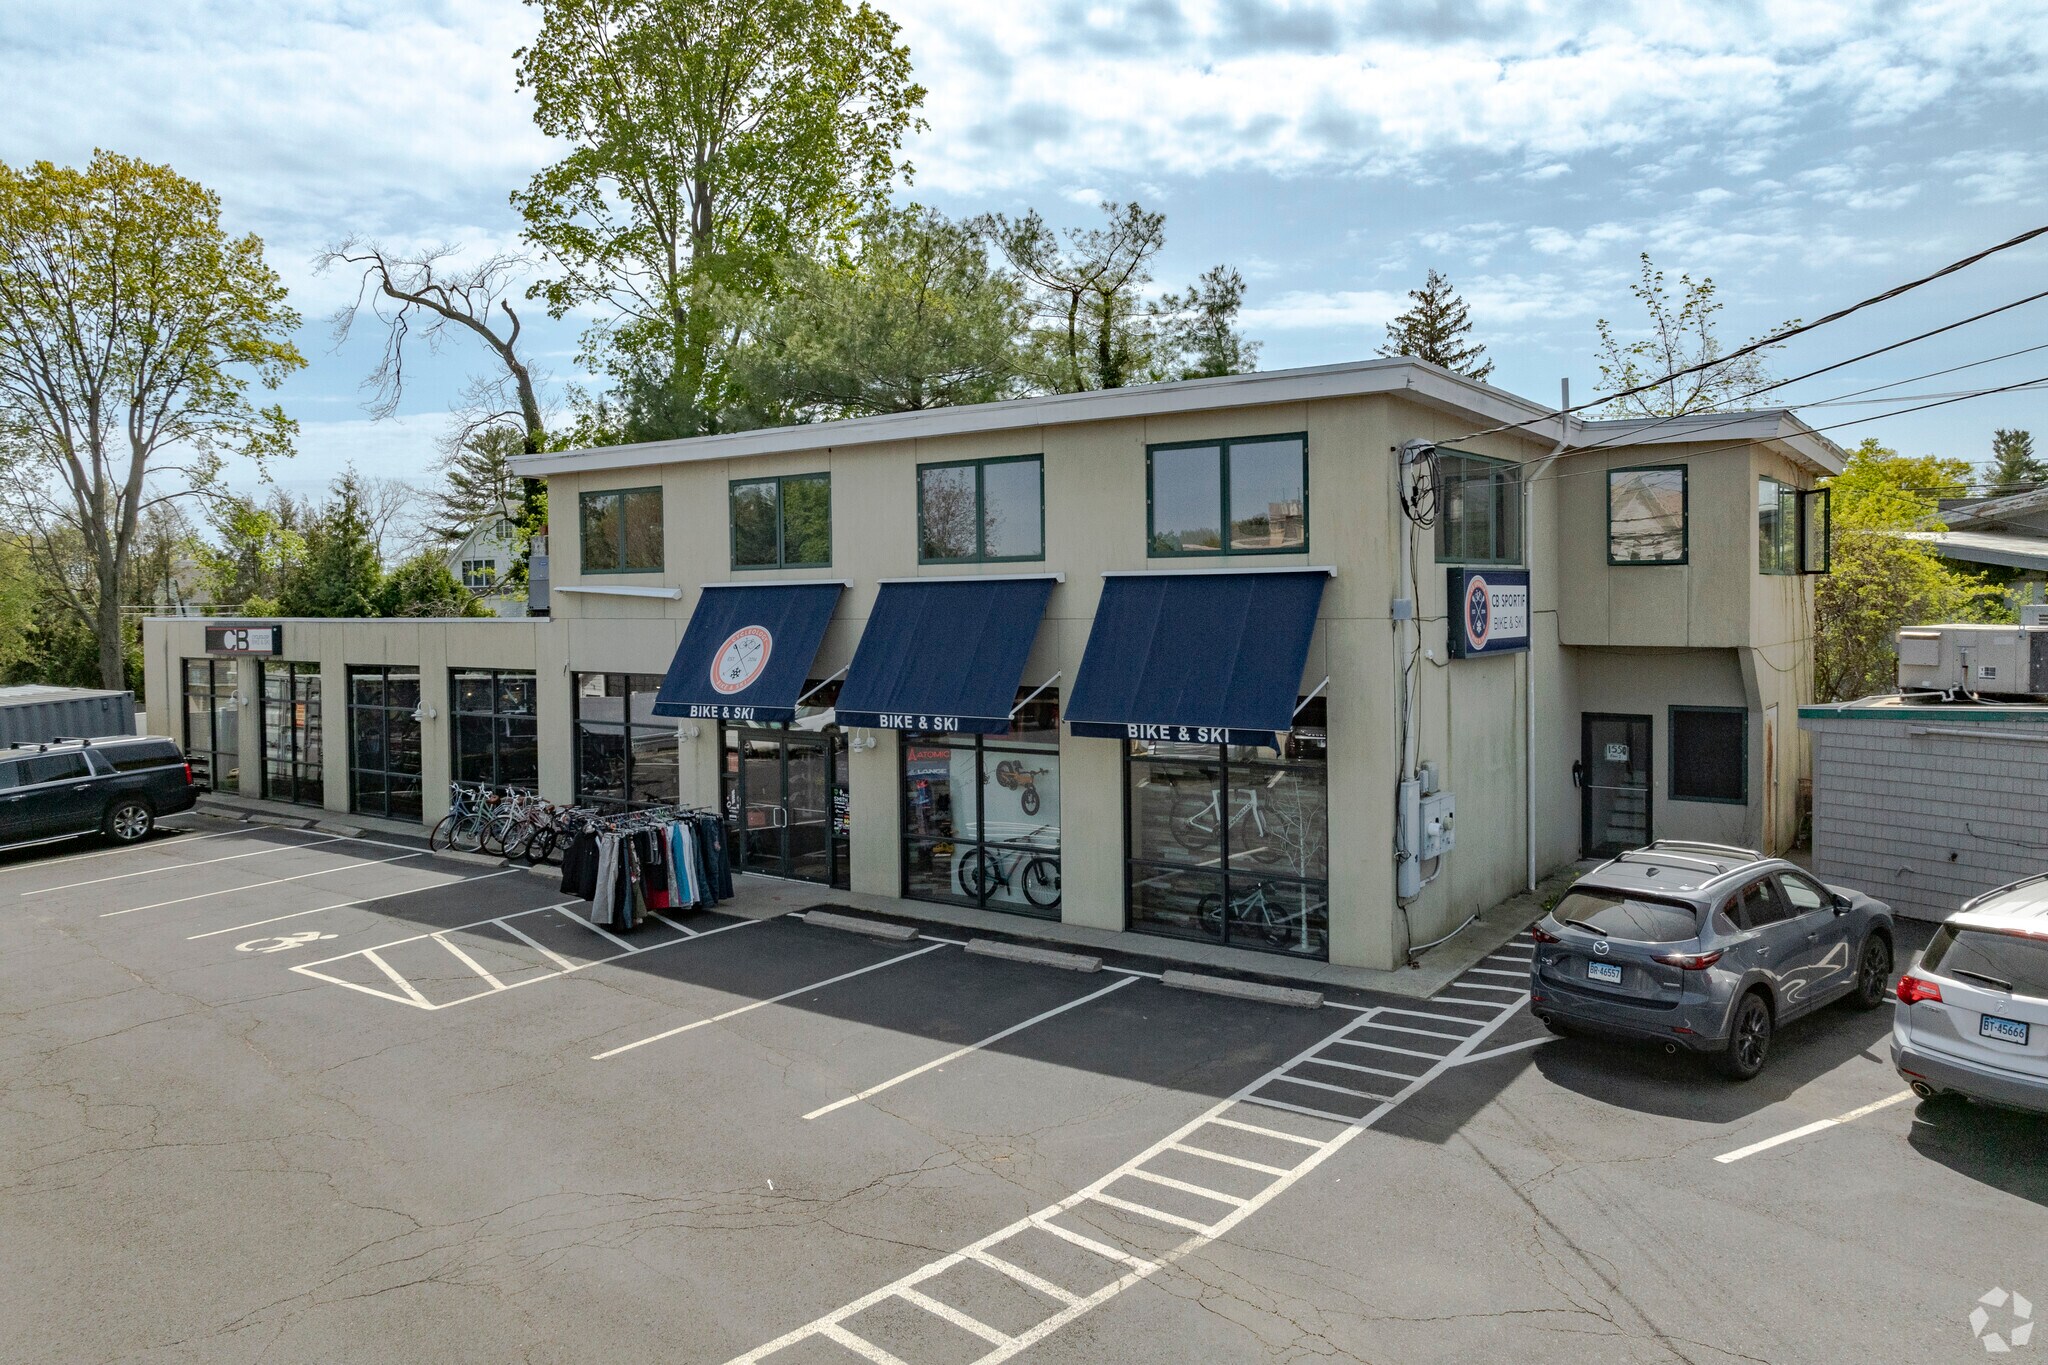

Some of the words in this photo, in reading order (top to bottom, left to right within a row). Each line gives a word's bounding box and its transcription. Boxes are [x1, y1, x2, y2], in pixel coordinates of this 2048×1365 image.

[1492, 594, 1499, 607] CB
[1501, 594, 1526, 607] SPORTIF
[1494, 617, 1508, 630] BIKE
[1509, 616, 1514, 629] &
[1515, 615, 1524, 628] SKI
[223, 629, 250, 650] CB
[731, 628, 769, 643] CYCLEOLOGY
[690, 705, 719, 718] BIKE
[722, 706, 730, 719] &
[733, 707, 755, 720] SKI
[880, 714, 913, 729] BIKE
[918, 716, 929, 730] &
[933, 716, 959, 731] SKI
[1127, 723, 1171, 740] BIKE
[1178, 726, 1191, 741] &
[1197, 727, 1230, 743] SKI
[916, 750, 950, 759] ATOMIC
[1589, 965, 1620, 979] BR-46557
[1983, 1020, 2025, 1039] BT-45666
